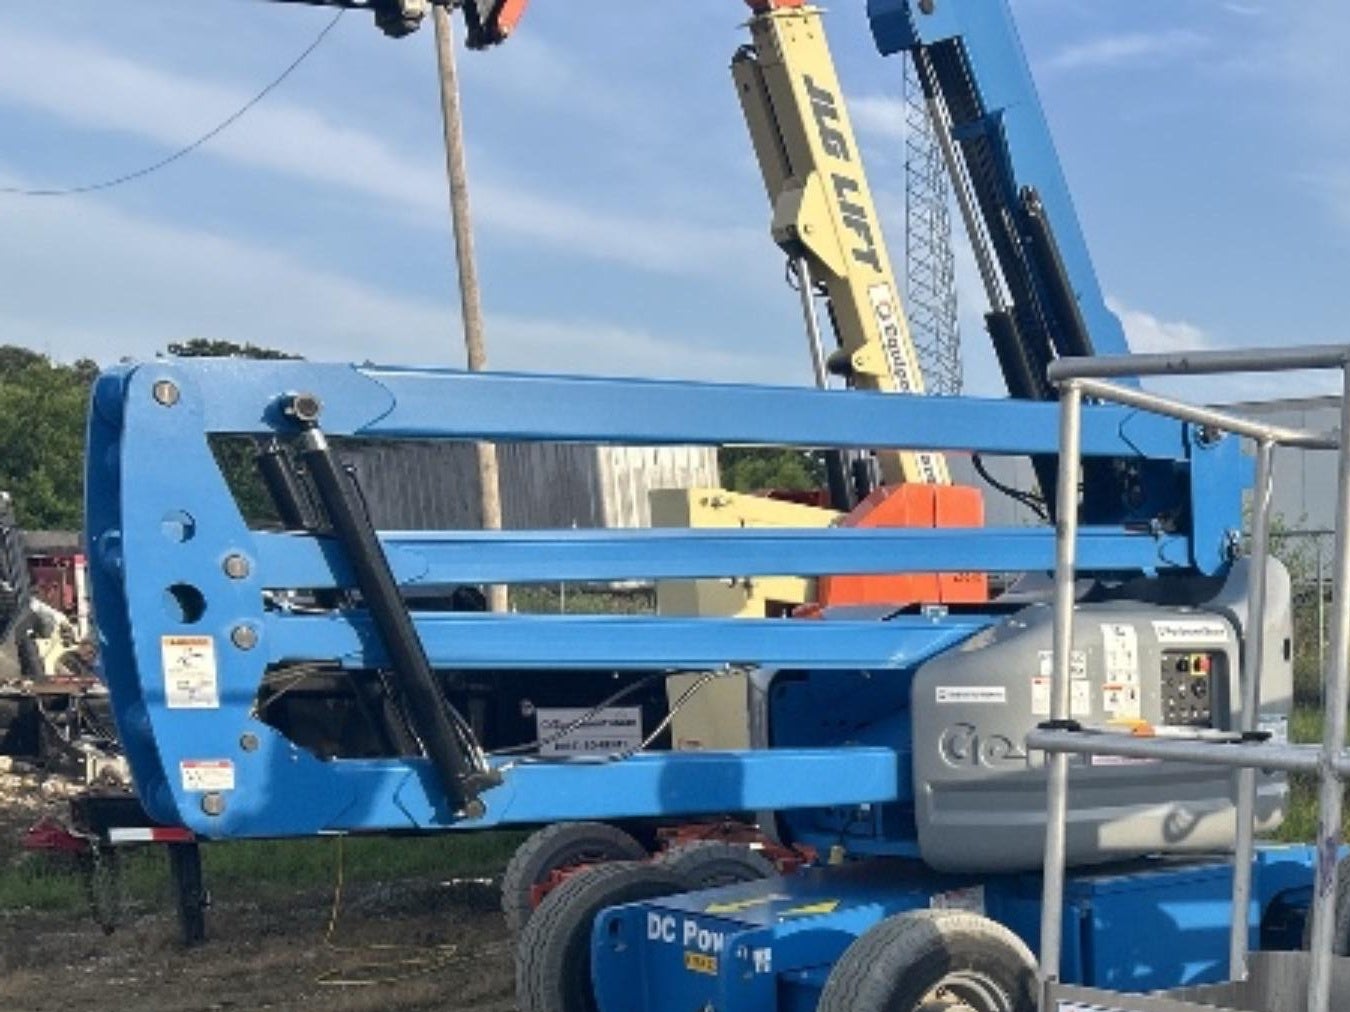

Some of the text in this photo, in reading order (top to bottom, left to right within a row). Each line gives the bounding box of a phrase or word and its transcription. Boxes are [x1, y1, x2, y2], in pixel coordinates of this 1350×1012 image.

[802, 73, 883, 273] JLG LIFT
[647, 911, 677, 943] DC
